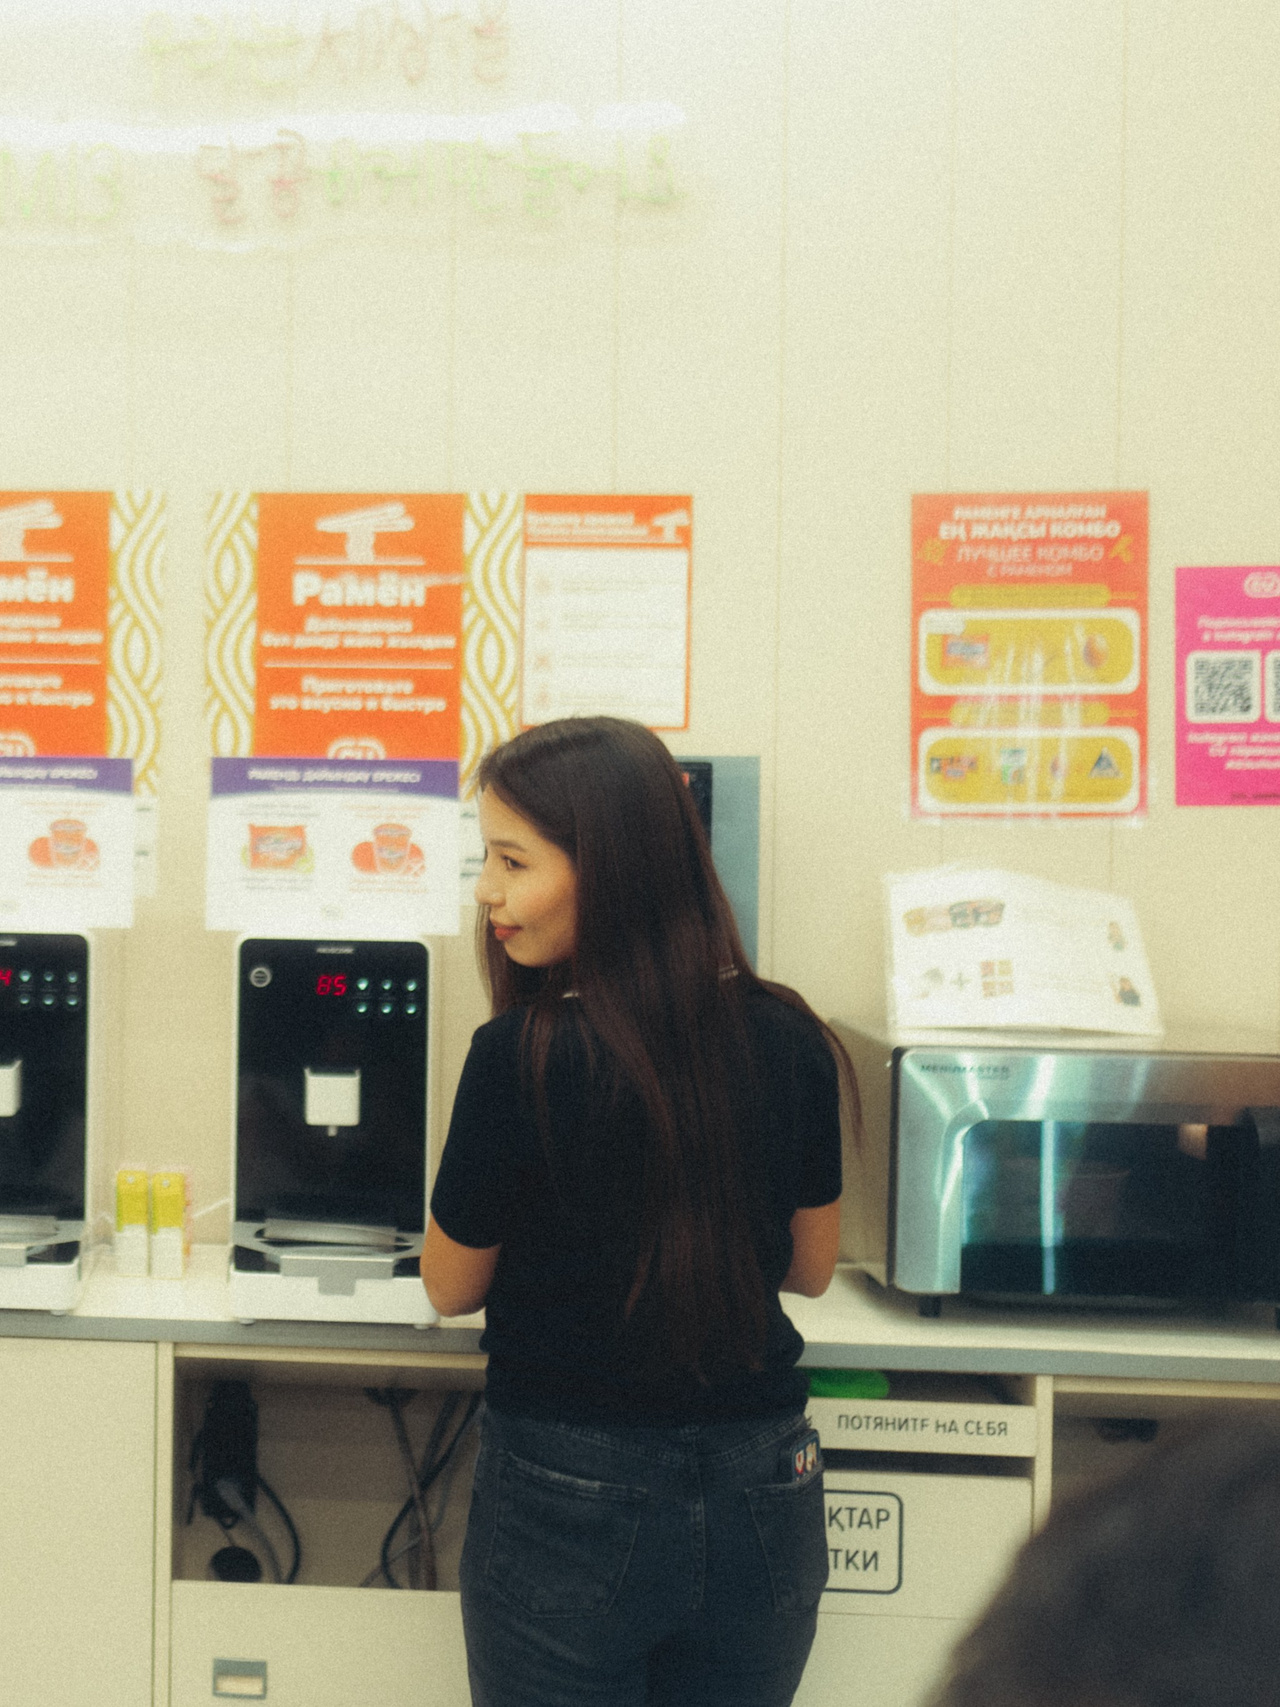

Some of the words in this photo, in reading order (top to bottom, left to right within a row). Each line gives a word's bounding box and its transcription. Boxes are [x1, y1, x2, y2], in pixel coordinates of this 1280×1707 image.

[1049, 519, 1122, 539] КОМБО
[291, 570, 428, 608] Рамён
[315, 973, 348, 997] 85
[837, 1414, 930, 1432] ПОТЯНИТЕ
[934, 1419, 959, 1436] НА
[963, 1420, 1009, 1437] СЕБЯ
[828, 1506, 891, 1533] ҚТАР
[828, 1548, 880, 1572] ТКИ
